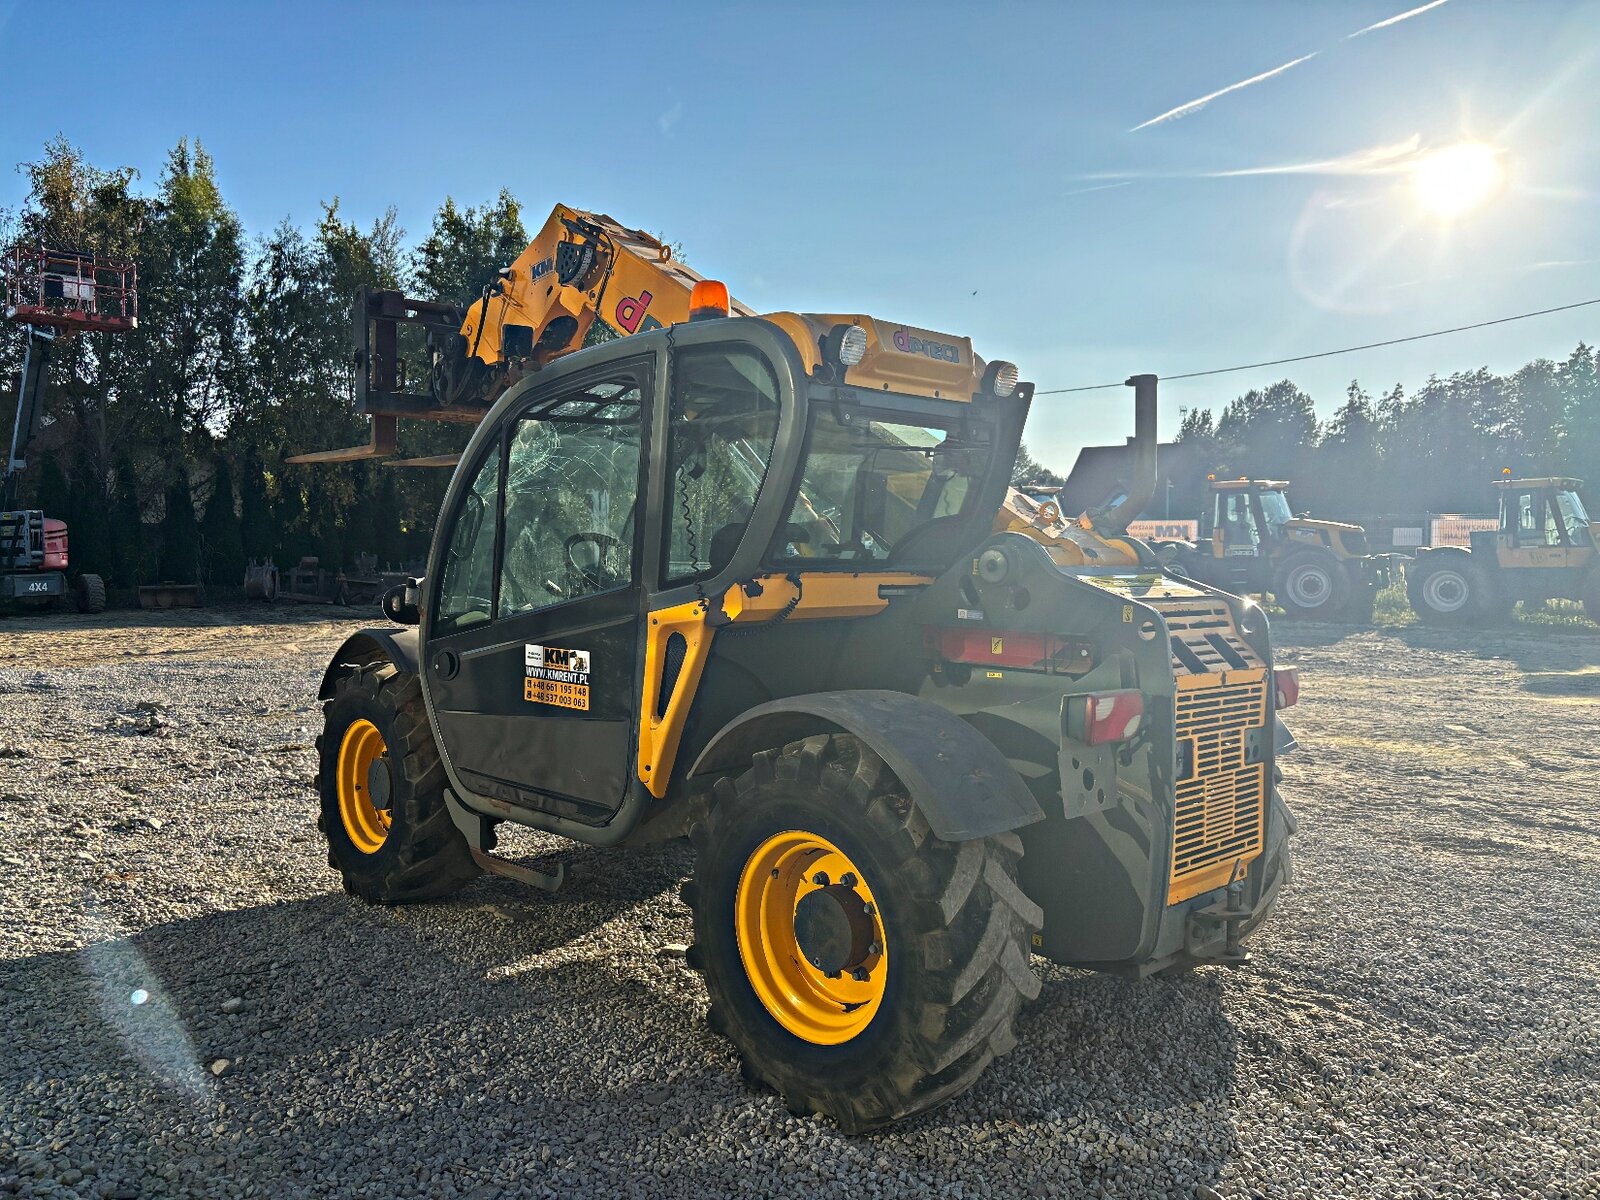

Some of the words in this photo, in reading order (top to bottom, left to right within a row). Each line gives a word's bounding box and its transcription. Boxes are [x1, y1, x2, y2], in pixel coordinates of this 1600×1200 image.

[29, 582, 48, 592] 4X4
[545, 649, 569, 666] KM
[526, 666, 589, 685] WWW.KMRENT.PL
[533, 681, 544, 690] +48
[560, 685, 572, 694] 195
[574, 687, 587, 696] 148
[533, 692, 544, 701] +48
[546, 694, 558, 703] 537
[559, 696, 571, 705] 003
[573, 698, 586, 707] 063
